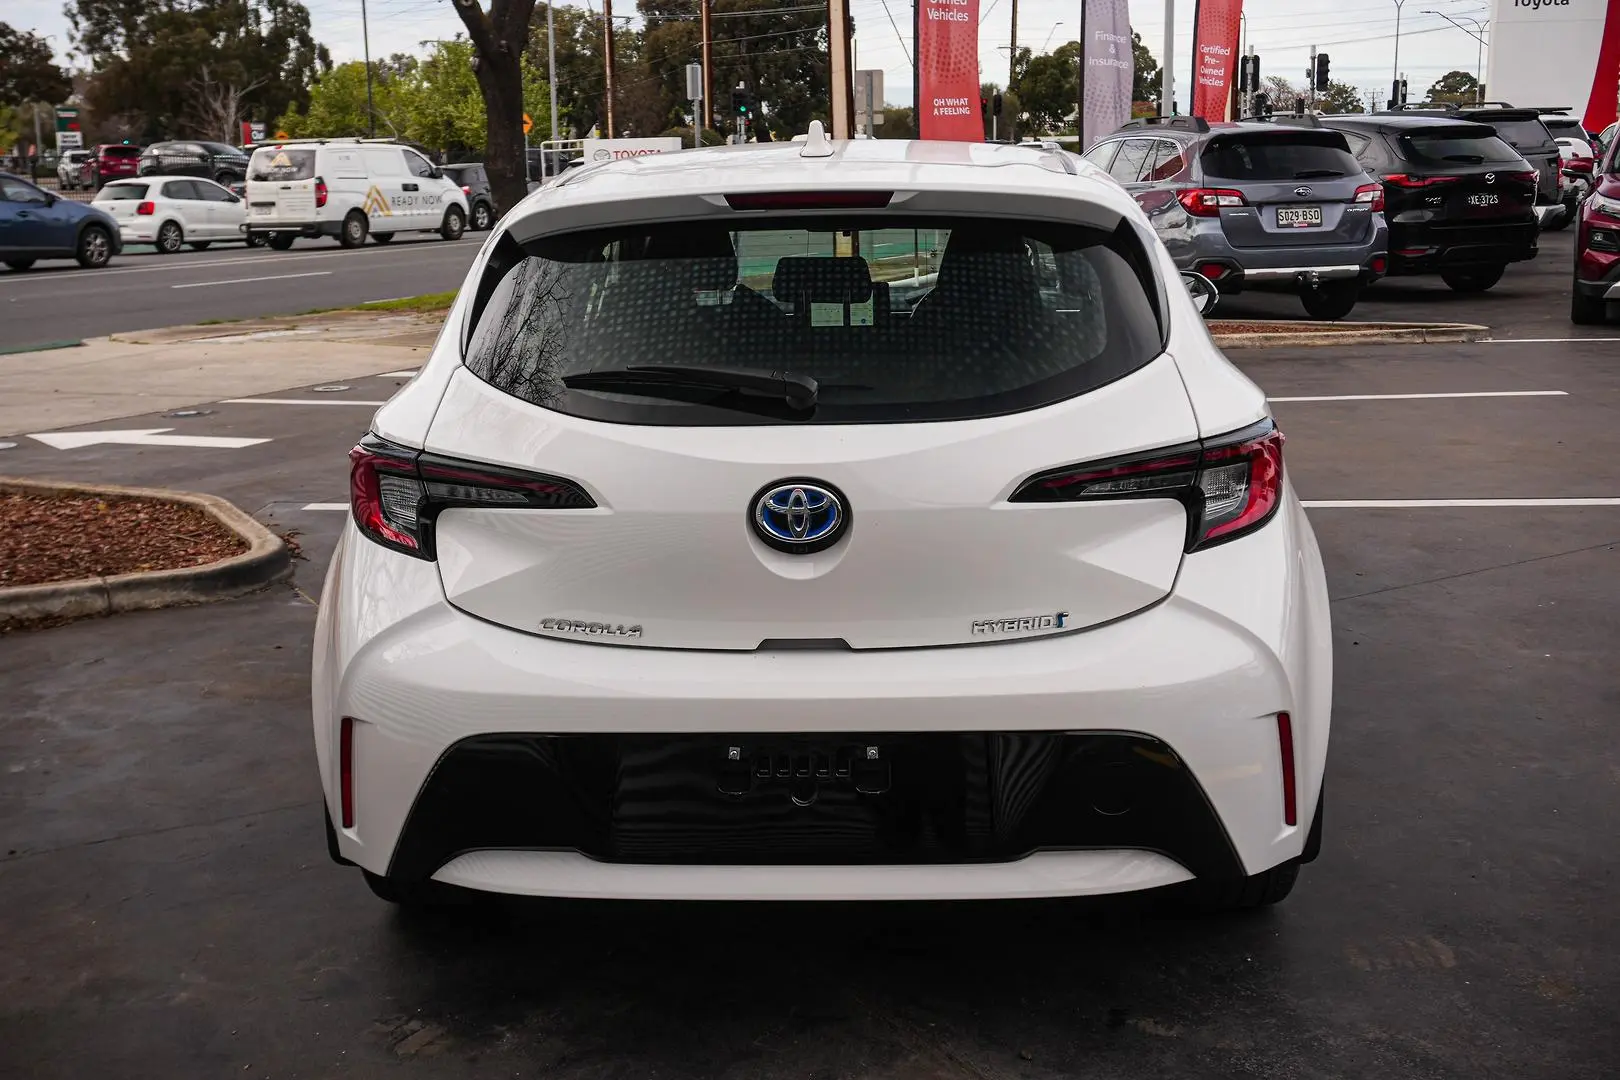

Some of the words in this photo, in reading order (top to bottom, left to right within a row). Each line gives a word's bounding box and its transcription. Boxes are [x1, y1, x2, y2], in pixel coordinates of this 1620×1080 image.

[927, 8, 969, 21] Vehicles
[1109, 43, 1115, 54] &
[1200, 44, 1230, 55] Certified
[1204, 55, 1220, 65] Pre-
[1200, 65, 1225, 76] Owned
[933, 98, 945, 106] OH
[945, 97, 969, 106] WHAT
[933, 107, 939, 116] A
[940, 107, 970, 116] FEELING
[612, 149, 662, 160] TOYO
[391, 195, 418, 206] READY
[422, 195, 442, 205] NOW
[540, 617, 642, 639] COROLLA
[972, 615, 1054, 635] HYBRID
